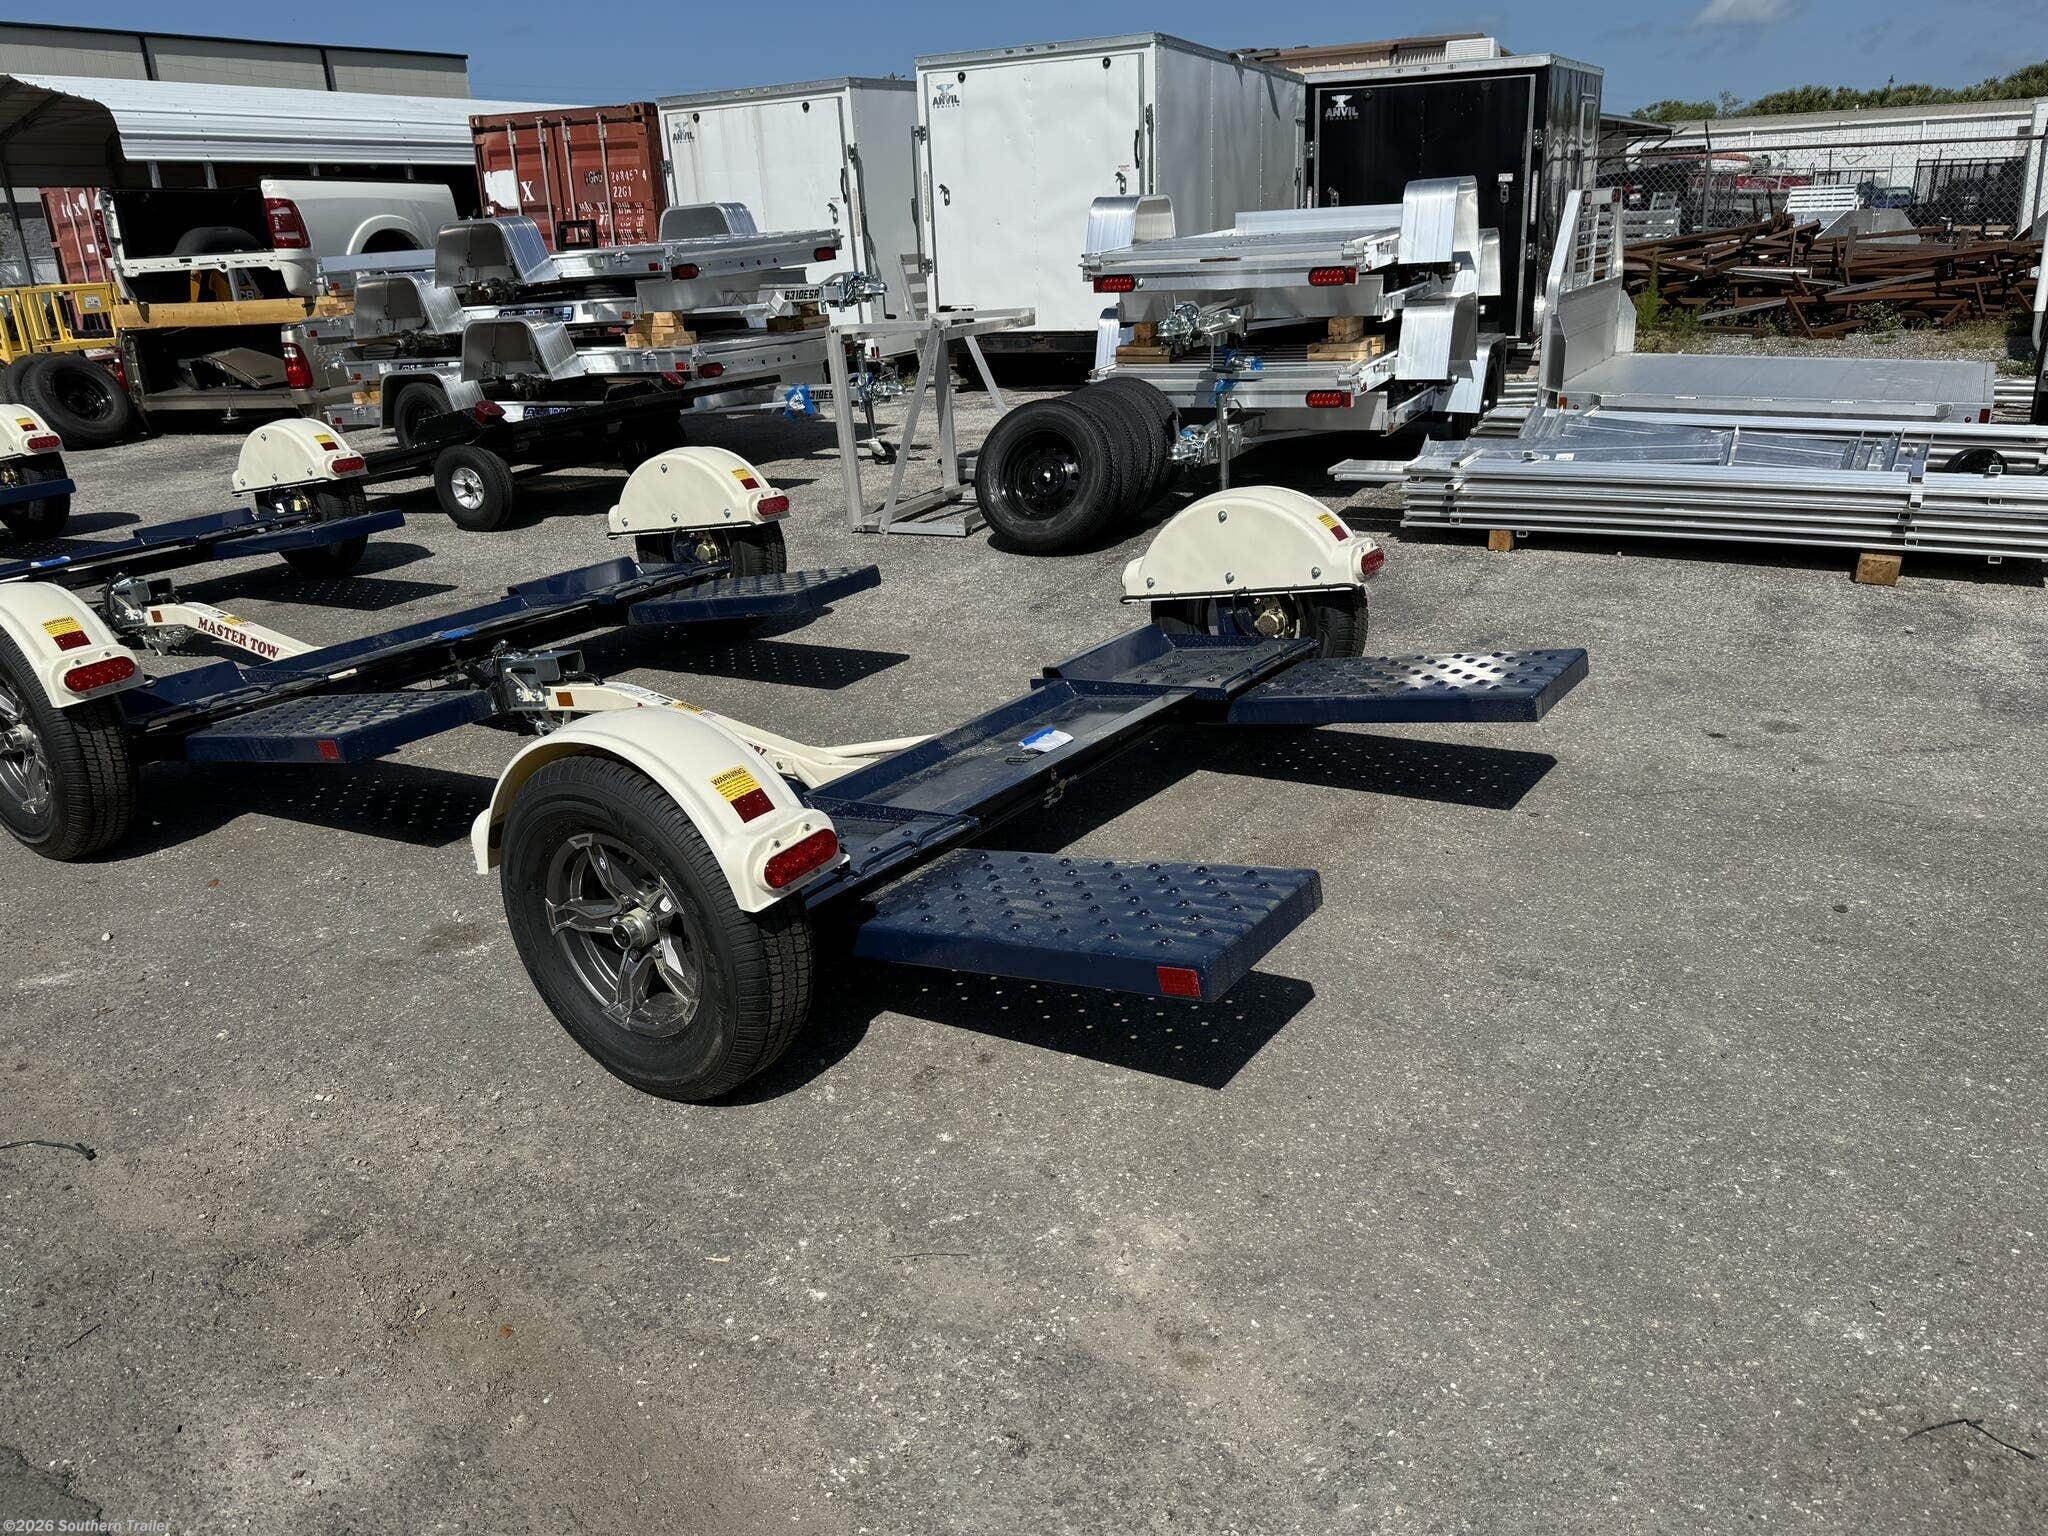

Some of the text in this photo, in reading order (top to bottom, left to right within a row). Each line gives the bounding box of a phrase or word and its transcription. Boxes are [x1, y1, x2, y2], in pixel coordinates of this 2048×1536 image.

[932, 94, 960, 106] ANVIL
[1325, 106, 1359, 117] ANVIL
[672, 131, 695, 141] ANVIL
[198, 616, 280, 659] MASTER TOW
[711, 767, 747, 786] WARNING
